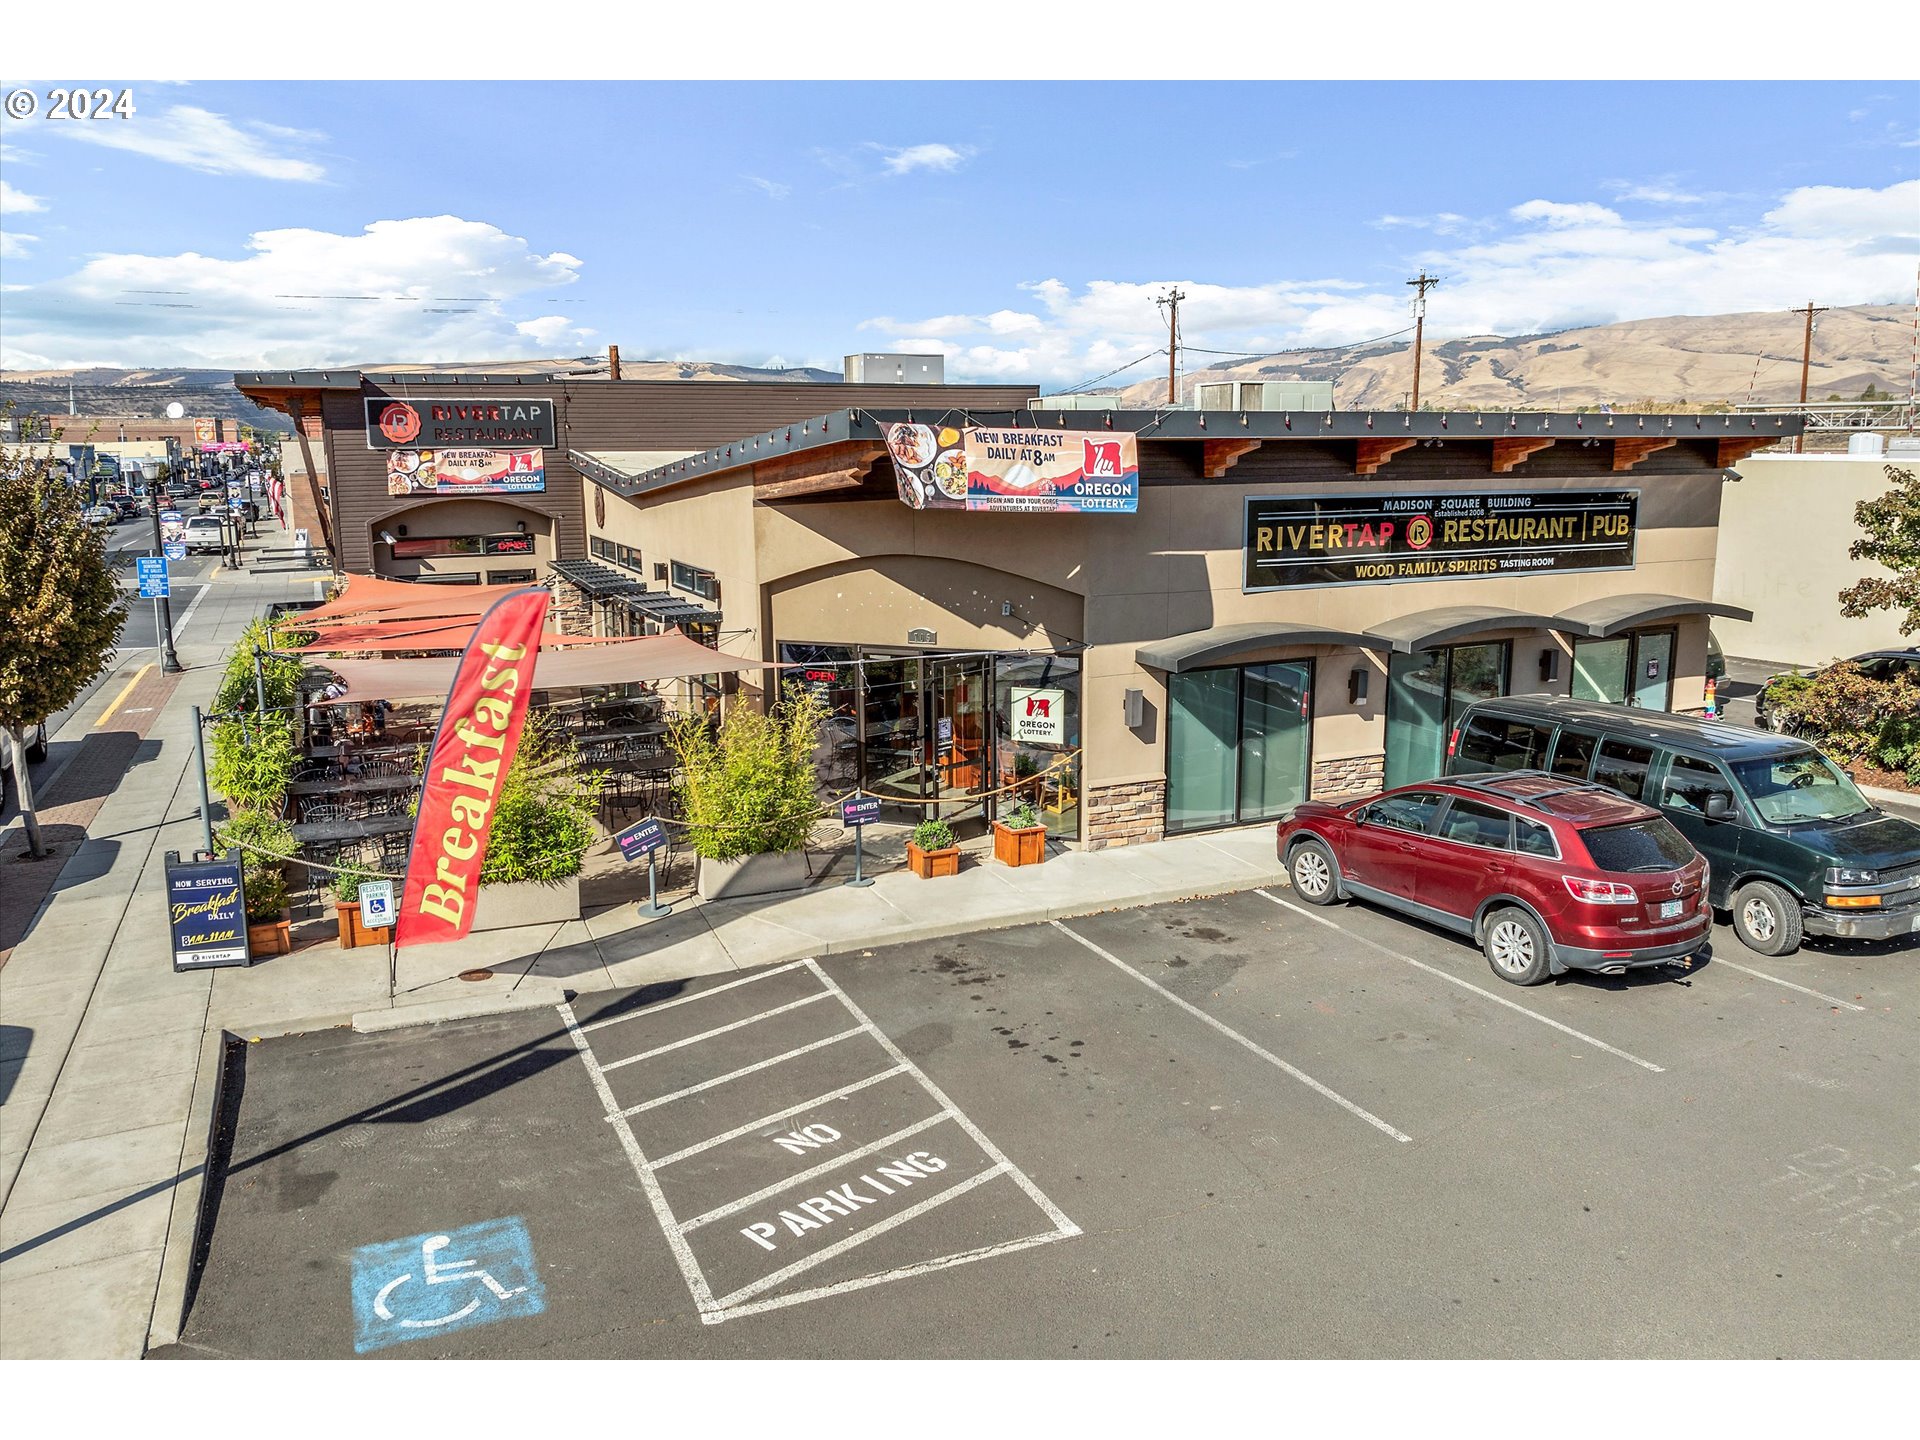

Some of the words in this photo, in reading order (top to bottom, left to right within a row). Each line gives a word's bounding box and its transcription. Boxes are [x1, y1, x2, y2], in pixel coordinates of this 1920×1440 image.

[431, 405, 541, 422] RIVERTAP
[434, 427, 543, 441] RESTAURANT
[974, 432, 1000, 445] NEW
[1002, 433, 1064, 447] BREAKFAST
[458, 451, 497, 459] BREAKFAST
[987, 446, 1017, 461] DAILY
[1019, 448, 1033, 461] AT
[448, 459, 467, 467] DAILY
[503, 475, 540, 484] OREGON
[1074, 482, 1132, 497] OREGON
[1027, 497, 1041, 505] YOUR
[1383, 499, 1433, 512] MADISON
[1440, 497, 1481, 511] SQUARE
[1487, 496, 1532, 509] BUILDING
[1434, 510, 1469, 518] Established
[1469, 509, 1485, 517] 2008
[1443, 516, 1579, 543] RESTAURANT
[1591, 514, 1630, 537] PUB
[1256, 522, 1395, 552] RIVERTAP
[1355, 563, 1395, 578] WOOD
[1398, 561, 1446, 577] FAMILY
[1448, 558, 1498, 574] SPIRITS
[1499, 558, 1531, 569] TASTING
[1531, 557, 1554, 567] ROOM
[805, 671, 836, 682] OPEN
[1019, 720, 1056, 729] OREGON
[419, 638, 527, 931] Breakfast
[857, 802, 878, 812] ENTER
[633, 824, 659, 841] ENTER
[175, 880, 192, 888] NOW
[195, 877, 233, 887] SERVING
[362, 883, 390, 893] RESERVED
[365, 891, 387, 899] PARKING
[171, 888, 241, 925] Breakfast
[207, 911, 235, 921] DAILY
[772, 1123, 842, 1156] NO
[739, 1151, 947, 1252] PARKING
